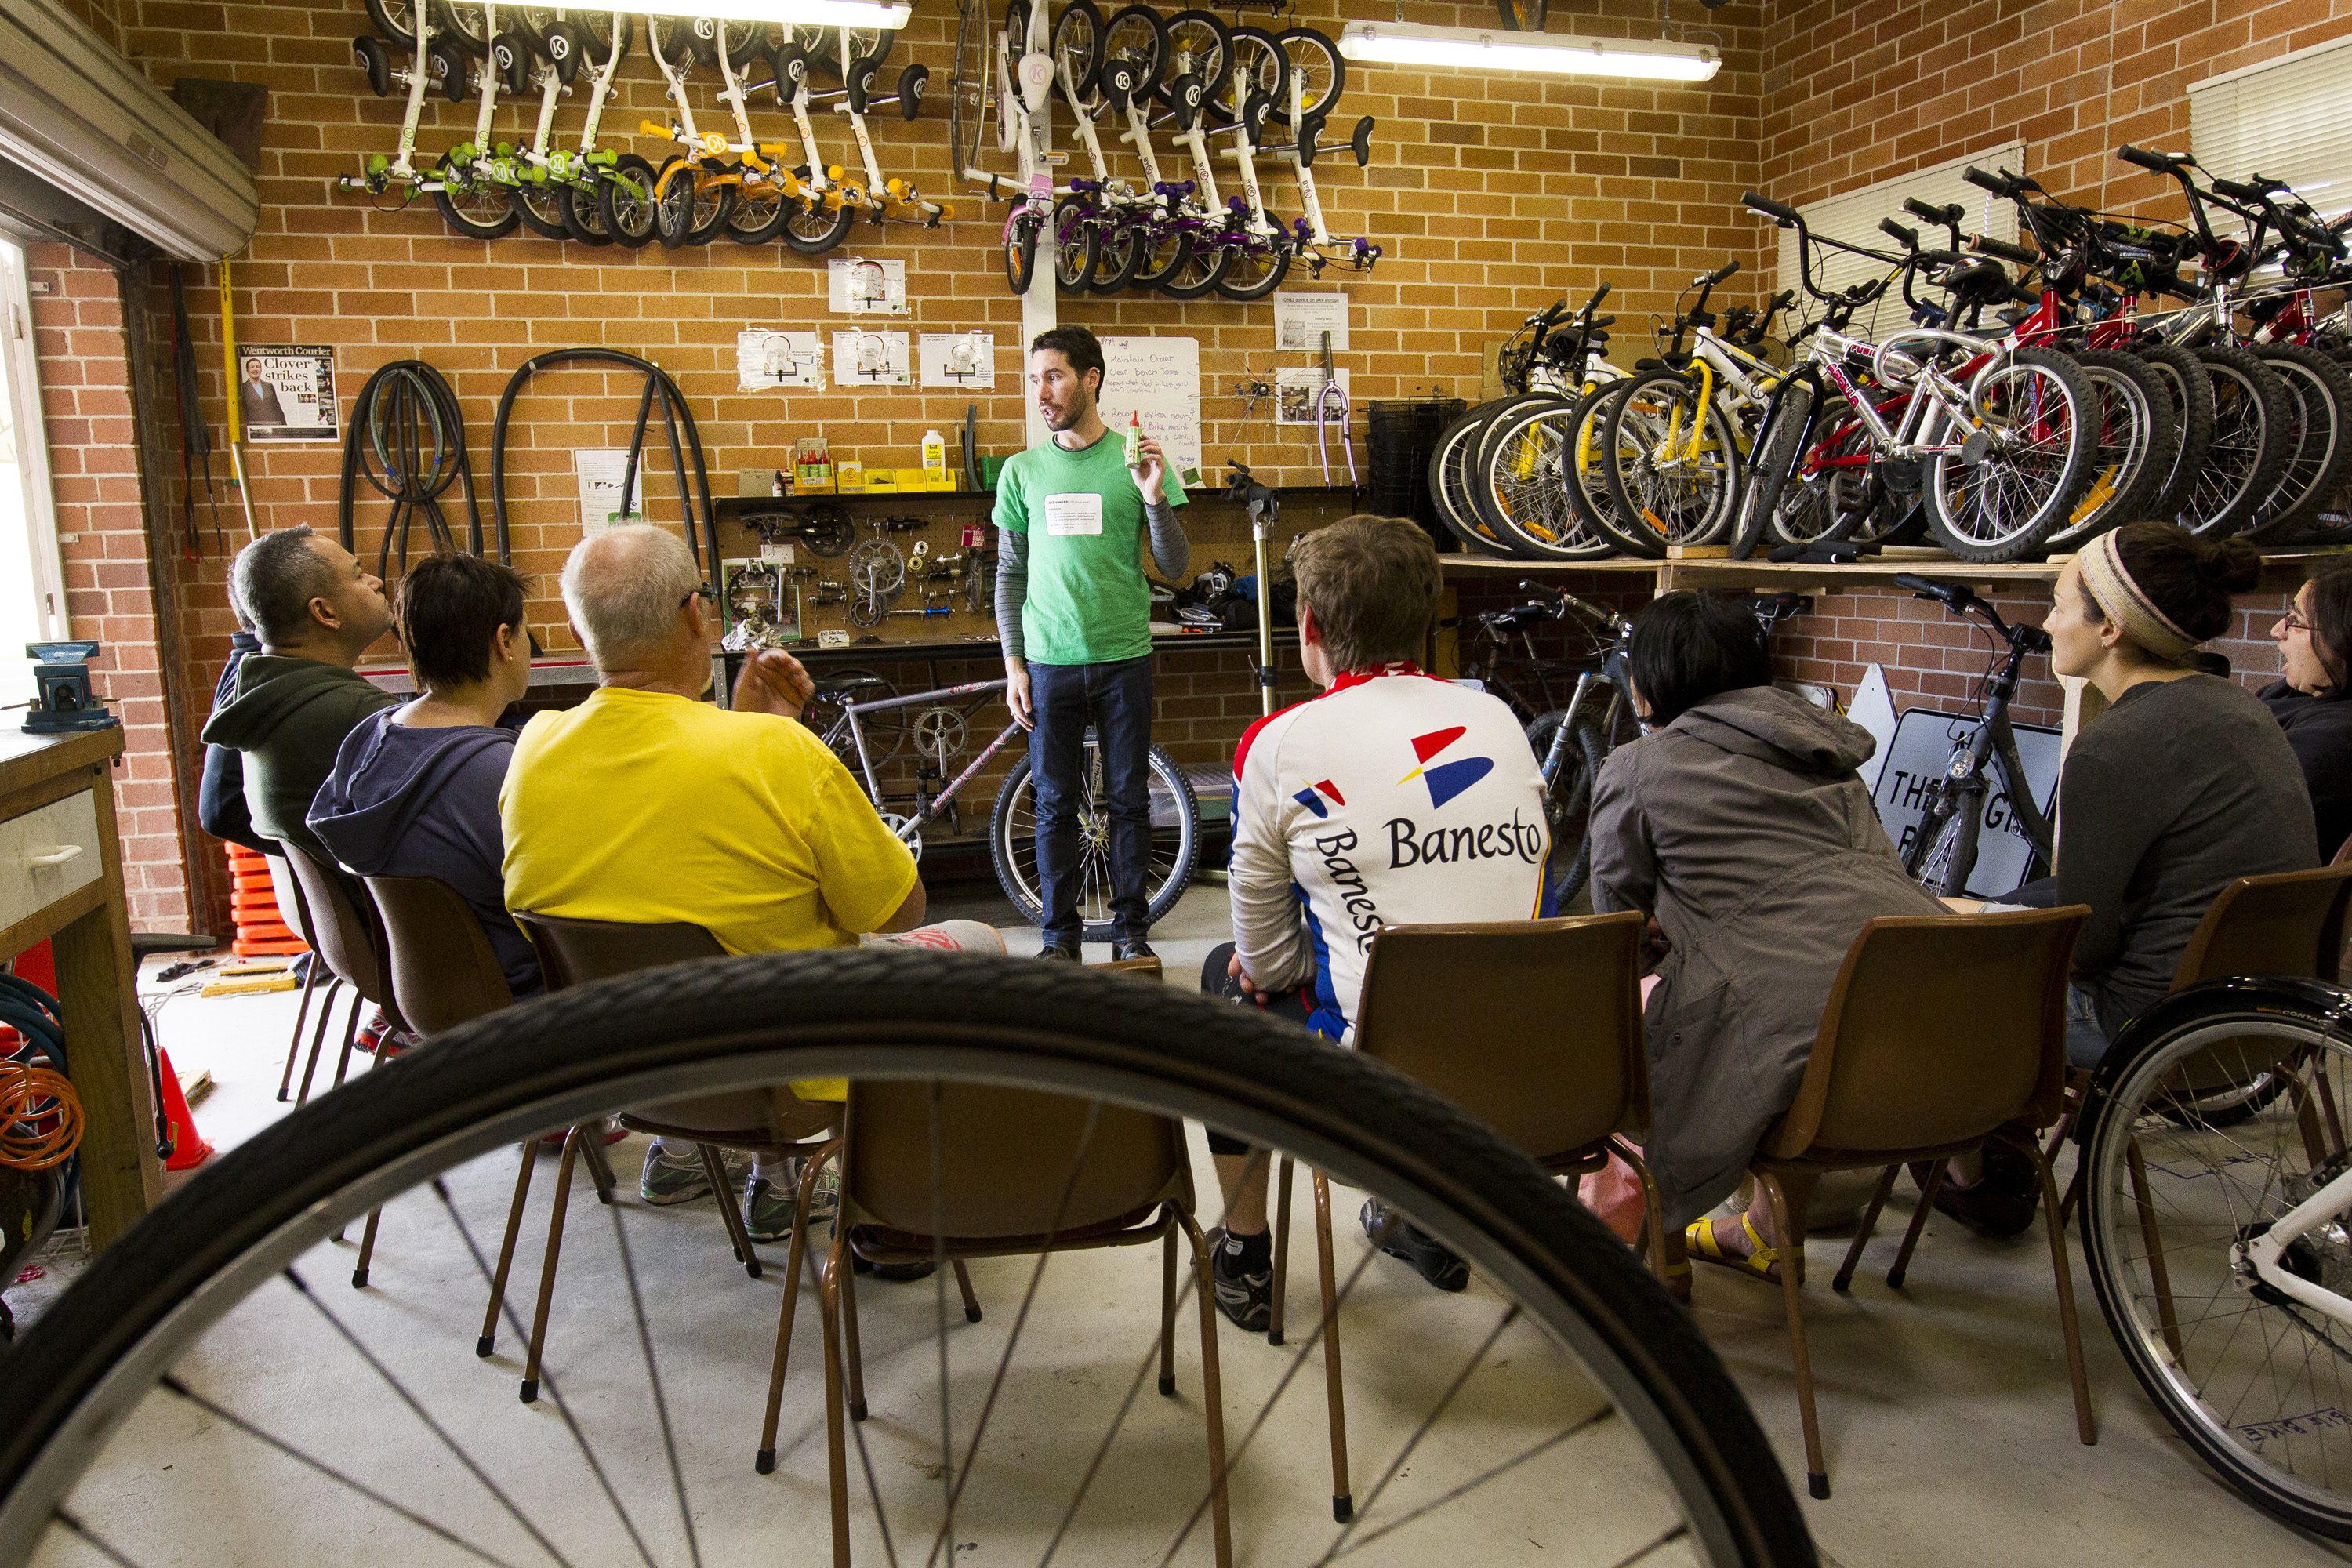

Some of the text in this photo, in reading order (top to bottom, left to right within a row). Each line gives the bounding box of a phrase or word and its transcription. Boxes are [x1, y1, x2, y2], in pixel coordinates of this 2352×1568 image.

[242, 346, 331, 355] Wentworth Courier
[264, 358, 309, 369] Clover
[1110, 354, 1174, 363] Maintain Order
[265, 370, 308, 381] strikes
[1134, 367, 1158, 376] Bench
[1160, 366, 1179, 377] Tops
[281, 382, 313, 392] back
[1828, 362, 1860, 408] APOLLO
[1145, 409, 1167, 419] extra
[1149, 422, 1165, 430] Bike
[1381, 807, 1541, 870] Banesto
[1315, 826, 1385, 958] Banest
[2282, 1010, 2322, 1023] CONTA
